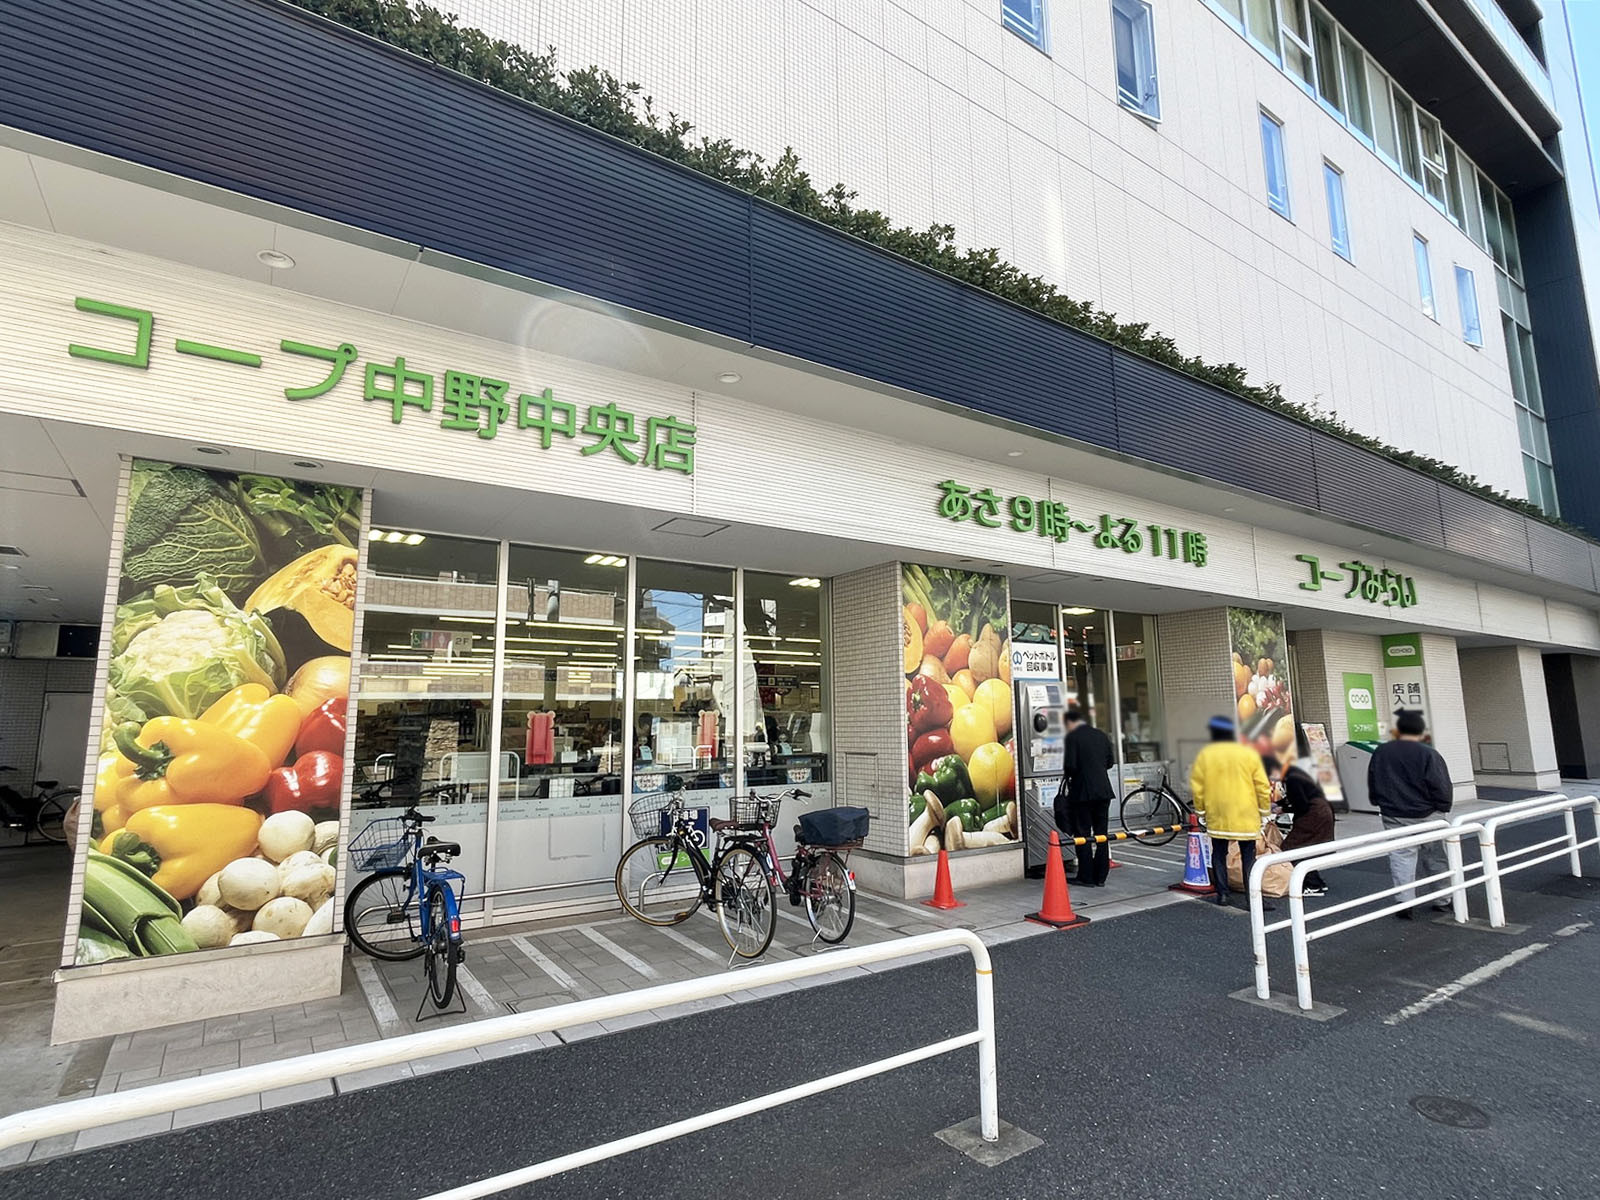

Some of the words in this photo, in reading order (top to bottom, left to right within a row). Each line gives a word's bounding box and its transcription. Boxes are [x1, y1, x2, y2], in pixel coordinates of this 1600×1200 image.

[68, 297, 698, 475] コープ中野中央店
[1296, 554, 1417, 608] コープみらい
[455, 637, 470, 645] 2F
[1022, 650, 1057, 661] ペットボトル
[1026, 661, 1054, 672] 回収事業
[1392, 683, 1420, 694] 店舗
[1394, 695, 1421, 705] 入口
